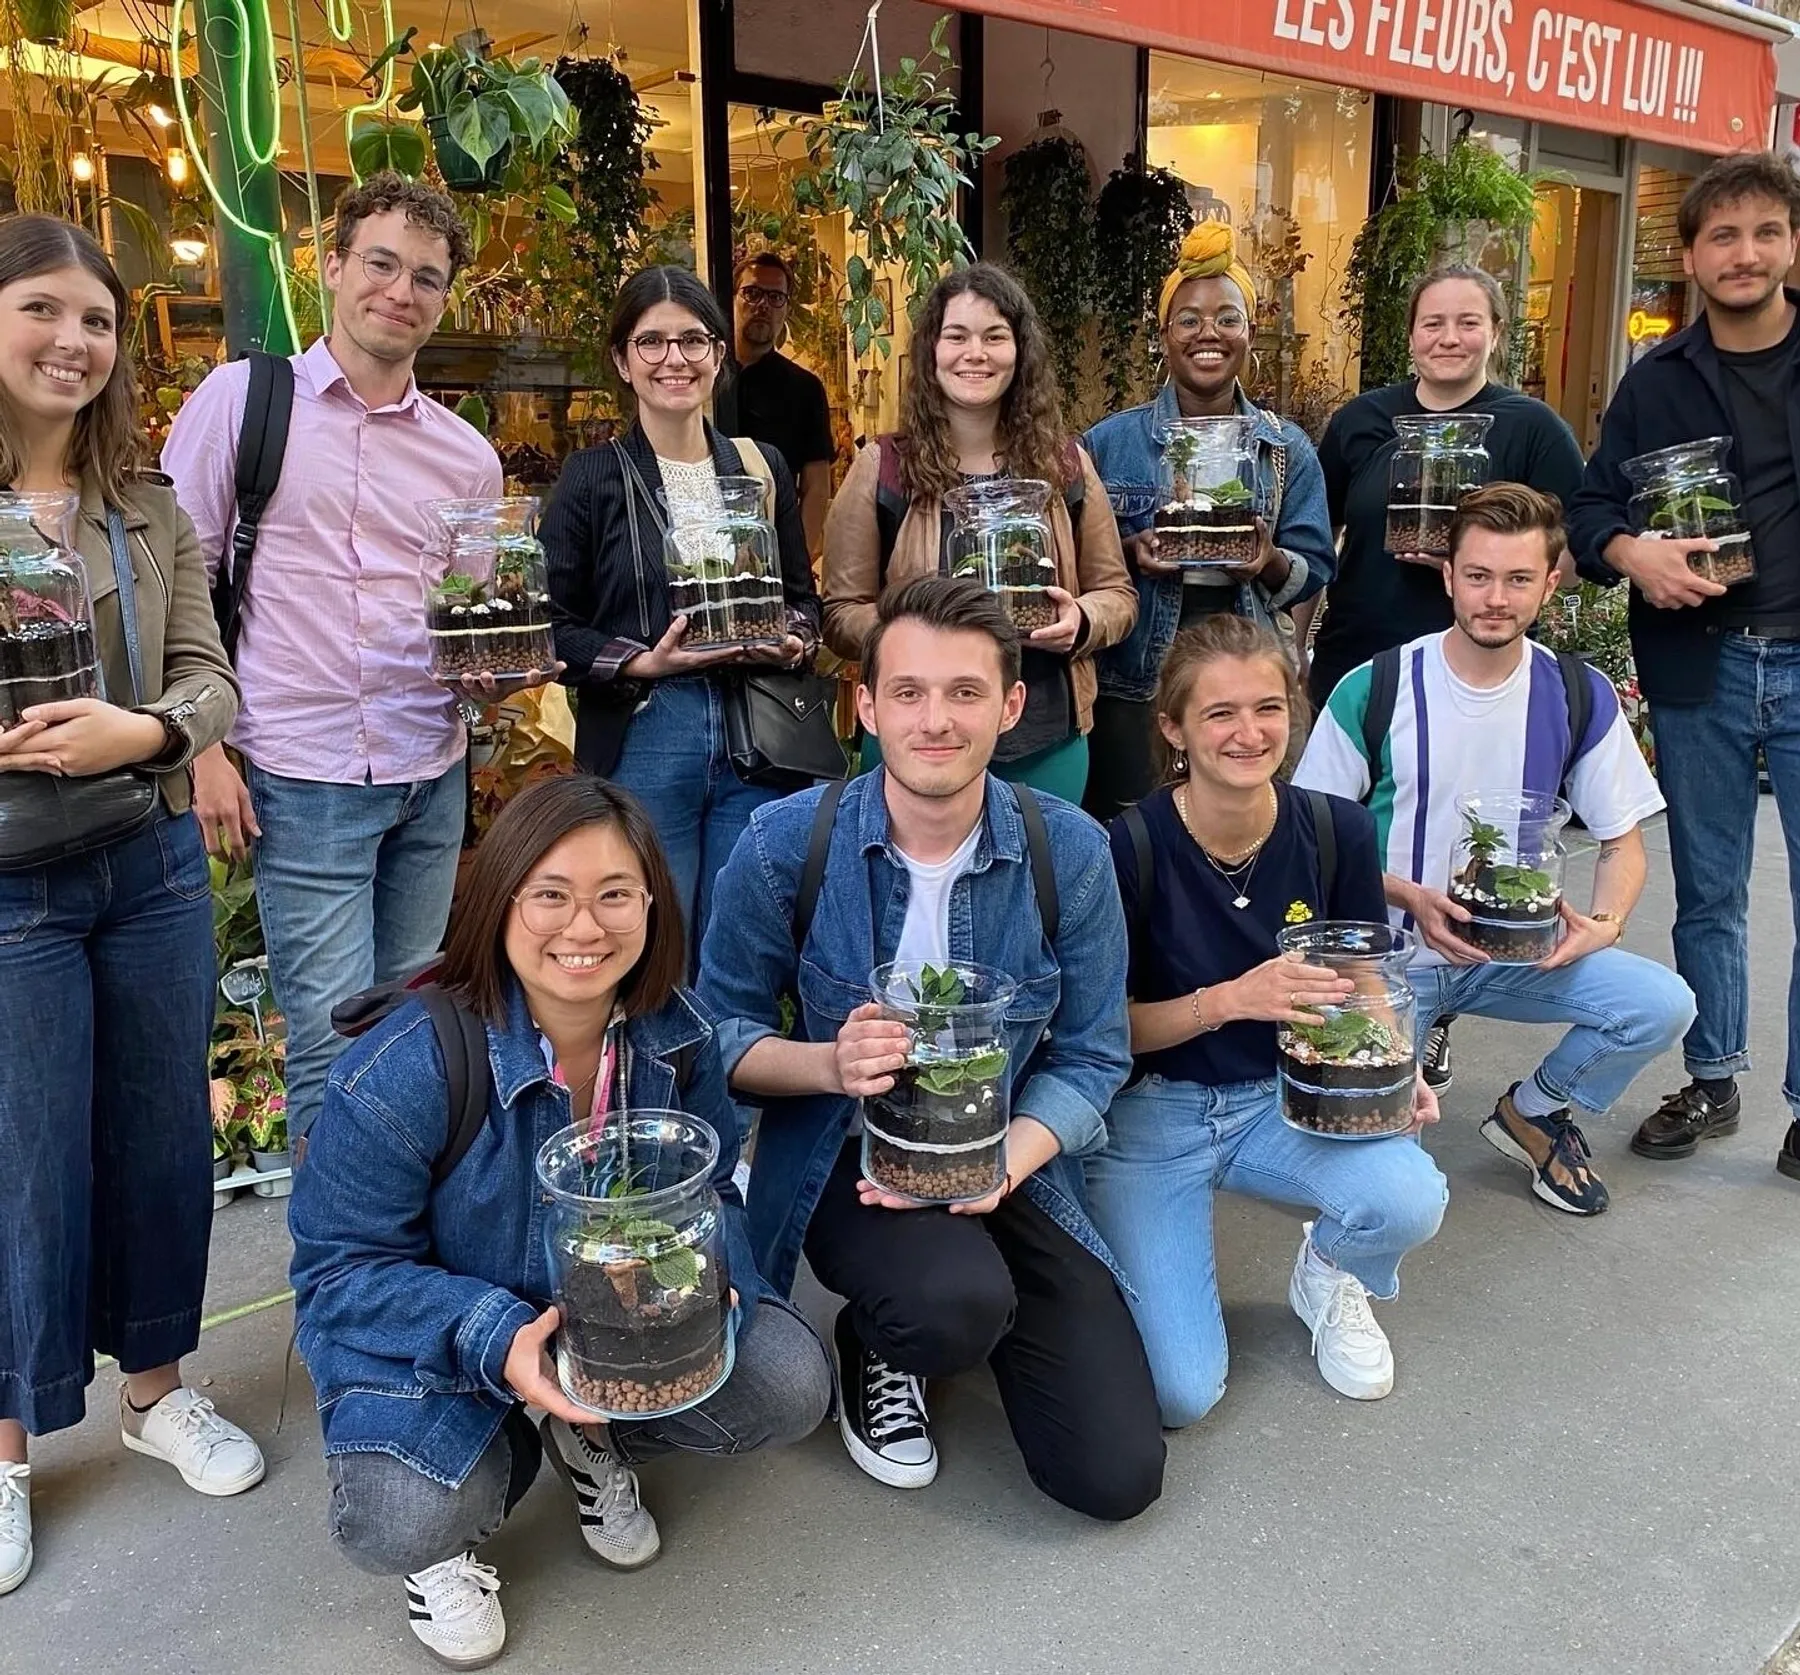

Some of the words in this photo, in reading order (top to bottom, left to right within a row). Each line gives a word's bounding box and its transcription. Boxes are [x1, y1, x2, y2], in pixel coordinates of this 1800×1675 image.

[1365, 0, 1515, 97] FLEURS,
[1527, 8, 1623, 105] C'EST
[1622, 33, 1672, 117] LUI
[1673, 46, 1704, 124] !!!
